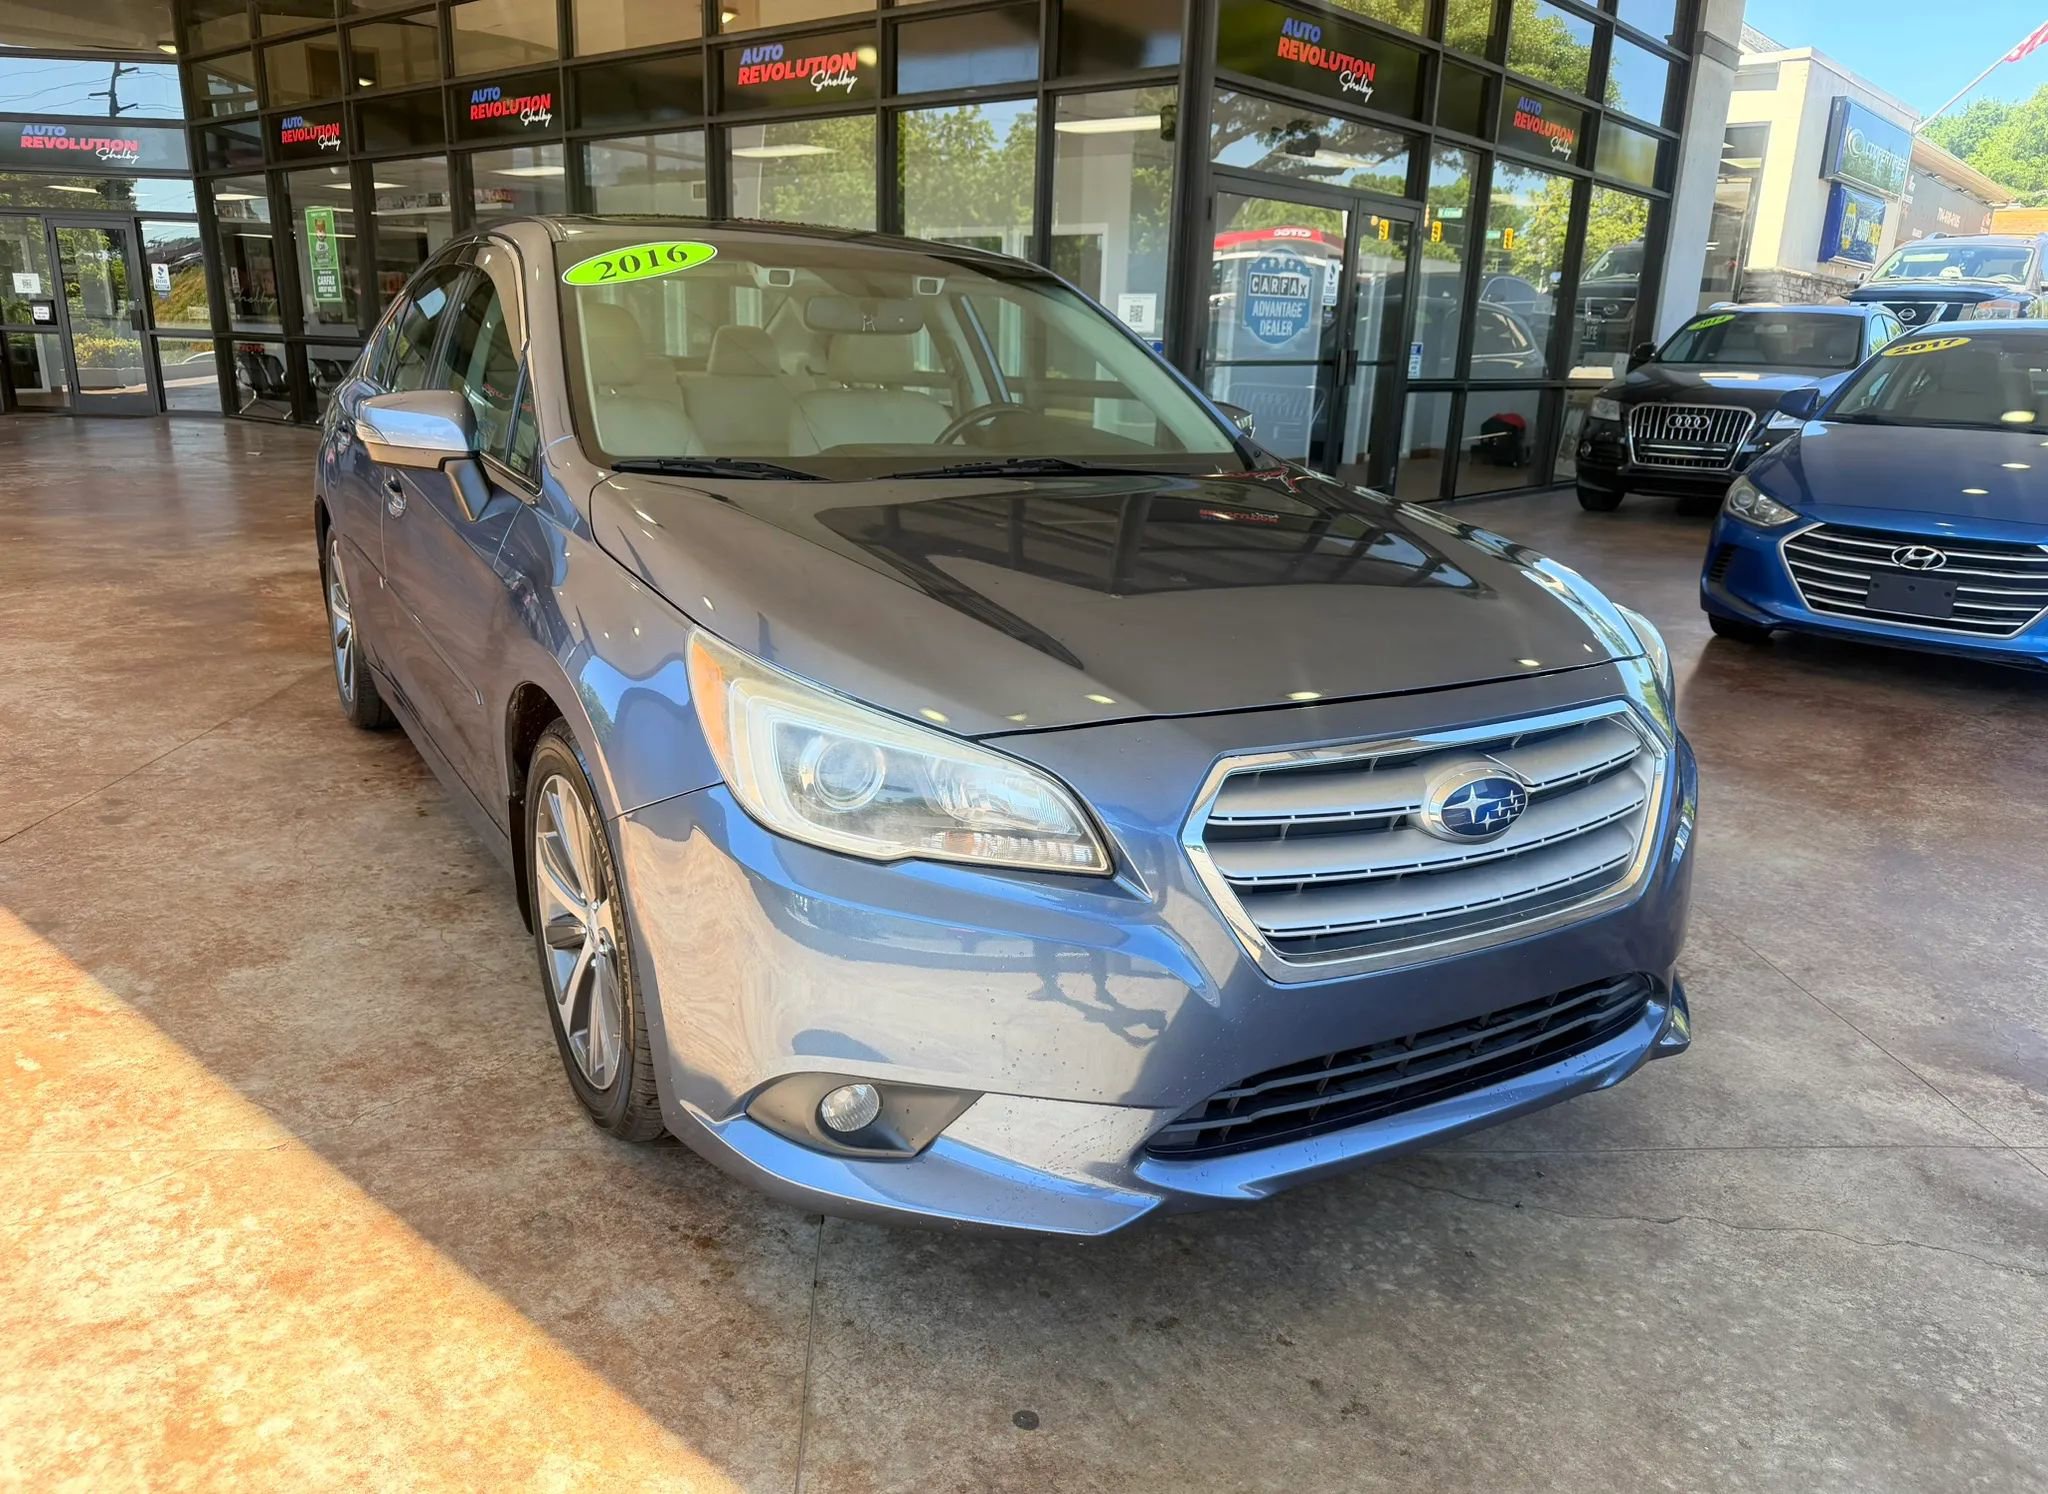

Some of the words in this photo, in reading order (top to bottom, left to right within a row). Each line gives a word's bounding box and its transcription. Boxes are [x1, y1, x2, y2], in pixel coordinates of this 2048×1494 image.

[1282, 17, 1321, 43] AUTO
[740, 44, 784, 65] AUTO
[1278, 36, 1376, 81] REVOLUTION
[738, 52, 857, 85] REVOLUTION
[810, 67, 858, 93] Shelby
[1339, 70, 1374, 103] Shelby
[471, 87, 501, 103] AUTO
[1517, 96, 1542, 115] AUTO
[470, 93, 551, 120] REVOLUTION
[520, 105, 552, 127] Shelby
[22, 125, 66, 136] AUTO
[281, 122, 340, 144] REVOLUTION
[282, 116, 304, 129] AUTO
[1514, 111, 1575, 144] REVOLUTION
[21, 136, 138, 151] REVOLUTION
[318, 134, 341, 151] Shelby
[1550, 136, 1572, 161] Shelby
[96, 147, 139, 164] Shelby
[594, 244, 688, 281] 2016
[1250, 273, 1311, 299] CARFAX
[1252, 301, 1303, 318] ADVANTAGE
[1259, 319, 1293, 336] DEALER
[1892, 338, 1960, 355] 2017
